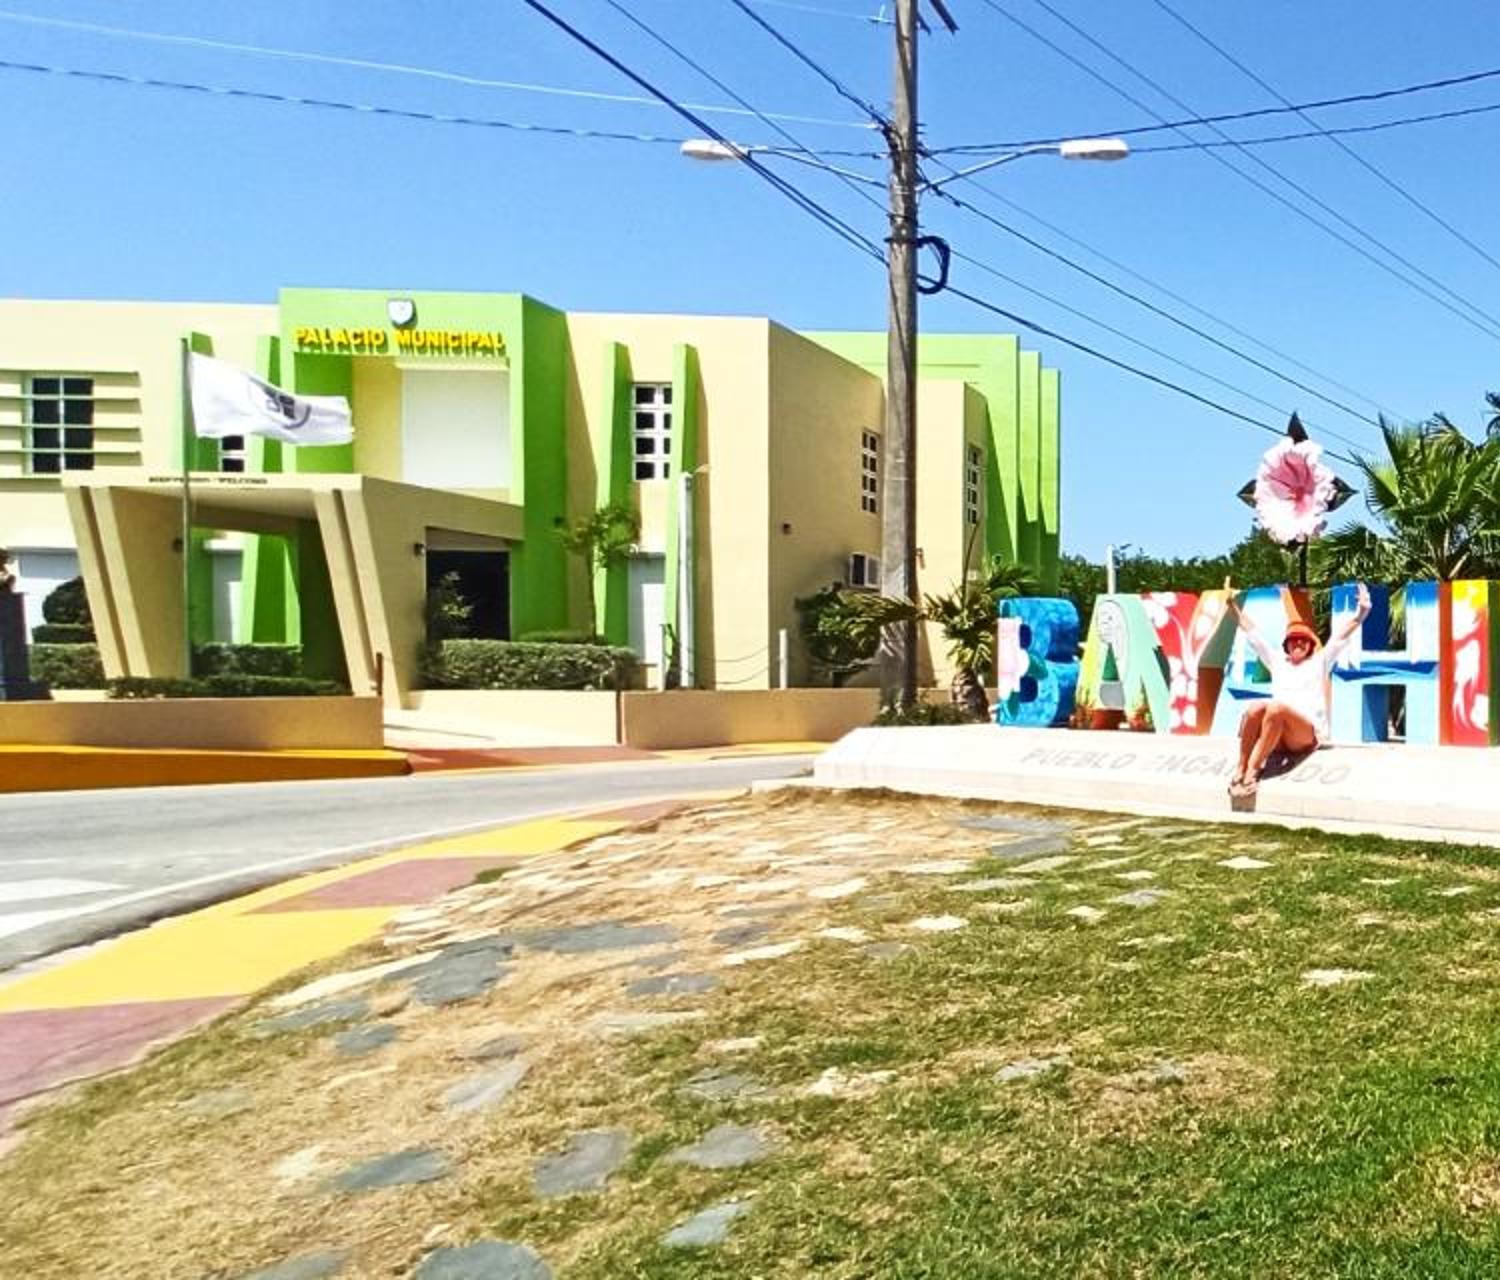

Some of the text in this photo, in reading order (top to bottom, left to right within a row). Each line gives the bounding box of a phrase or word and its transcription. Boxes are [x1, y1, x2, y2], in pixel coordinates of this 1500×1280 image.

[295, 328, 506, 351] PALACIO MUNICIPAL
[1019, 747, 1137, 769] PUEBLO
